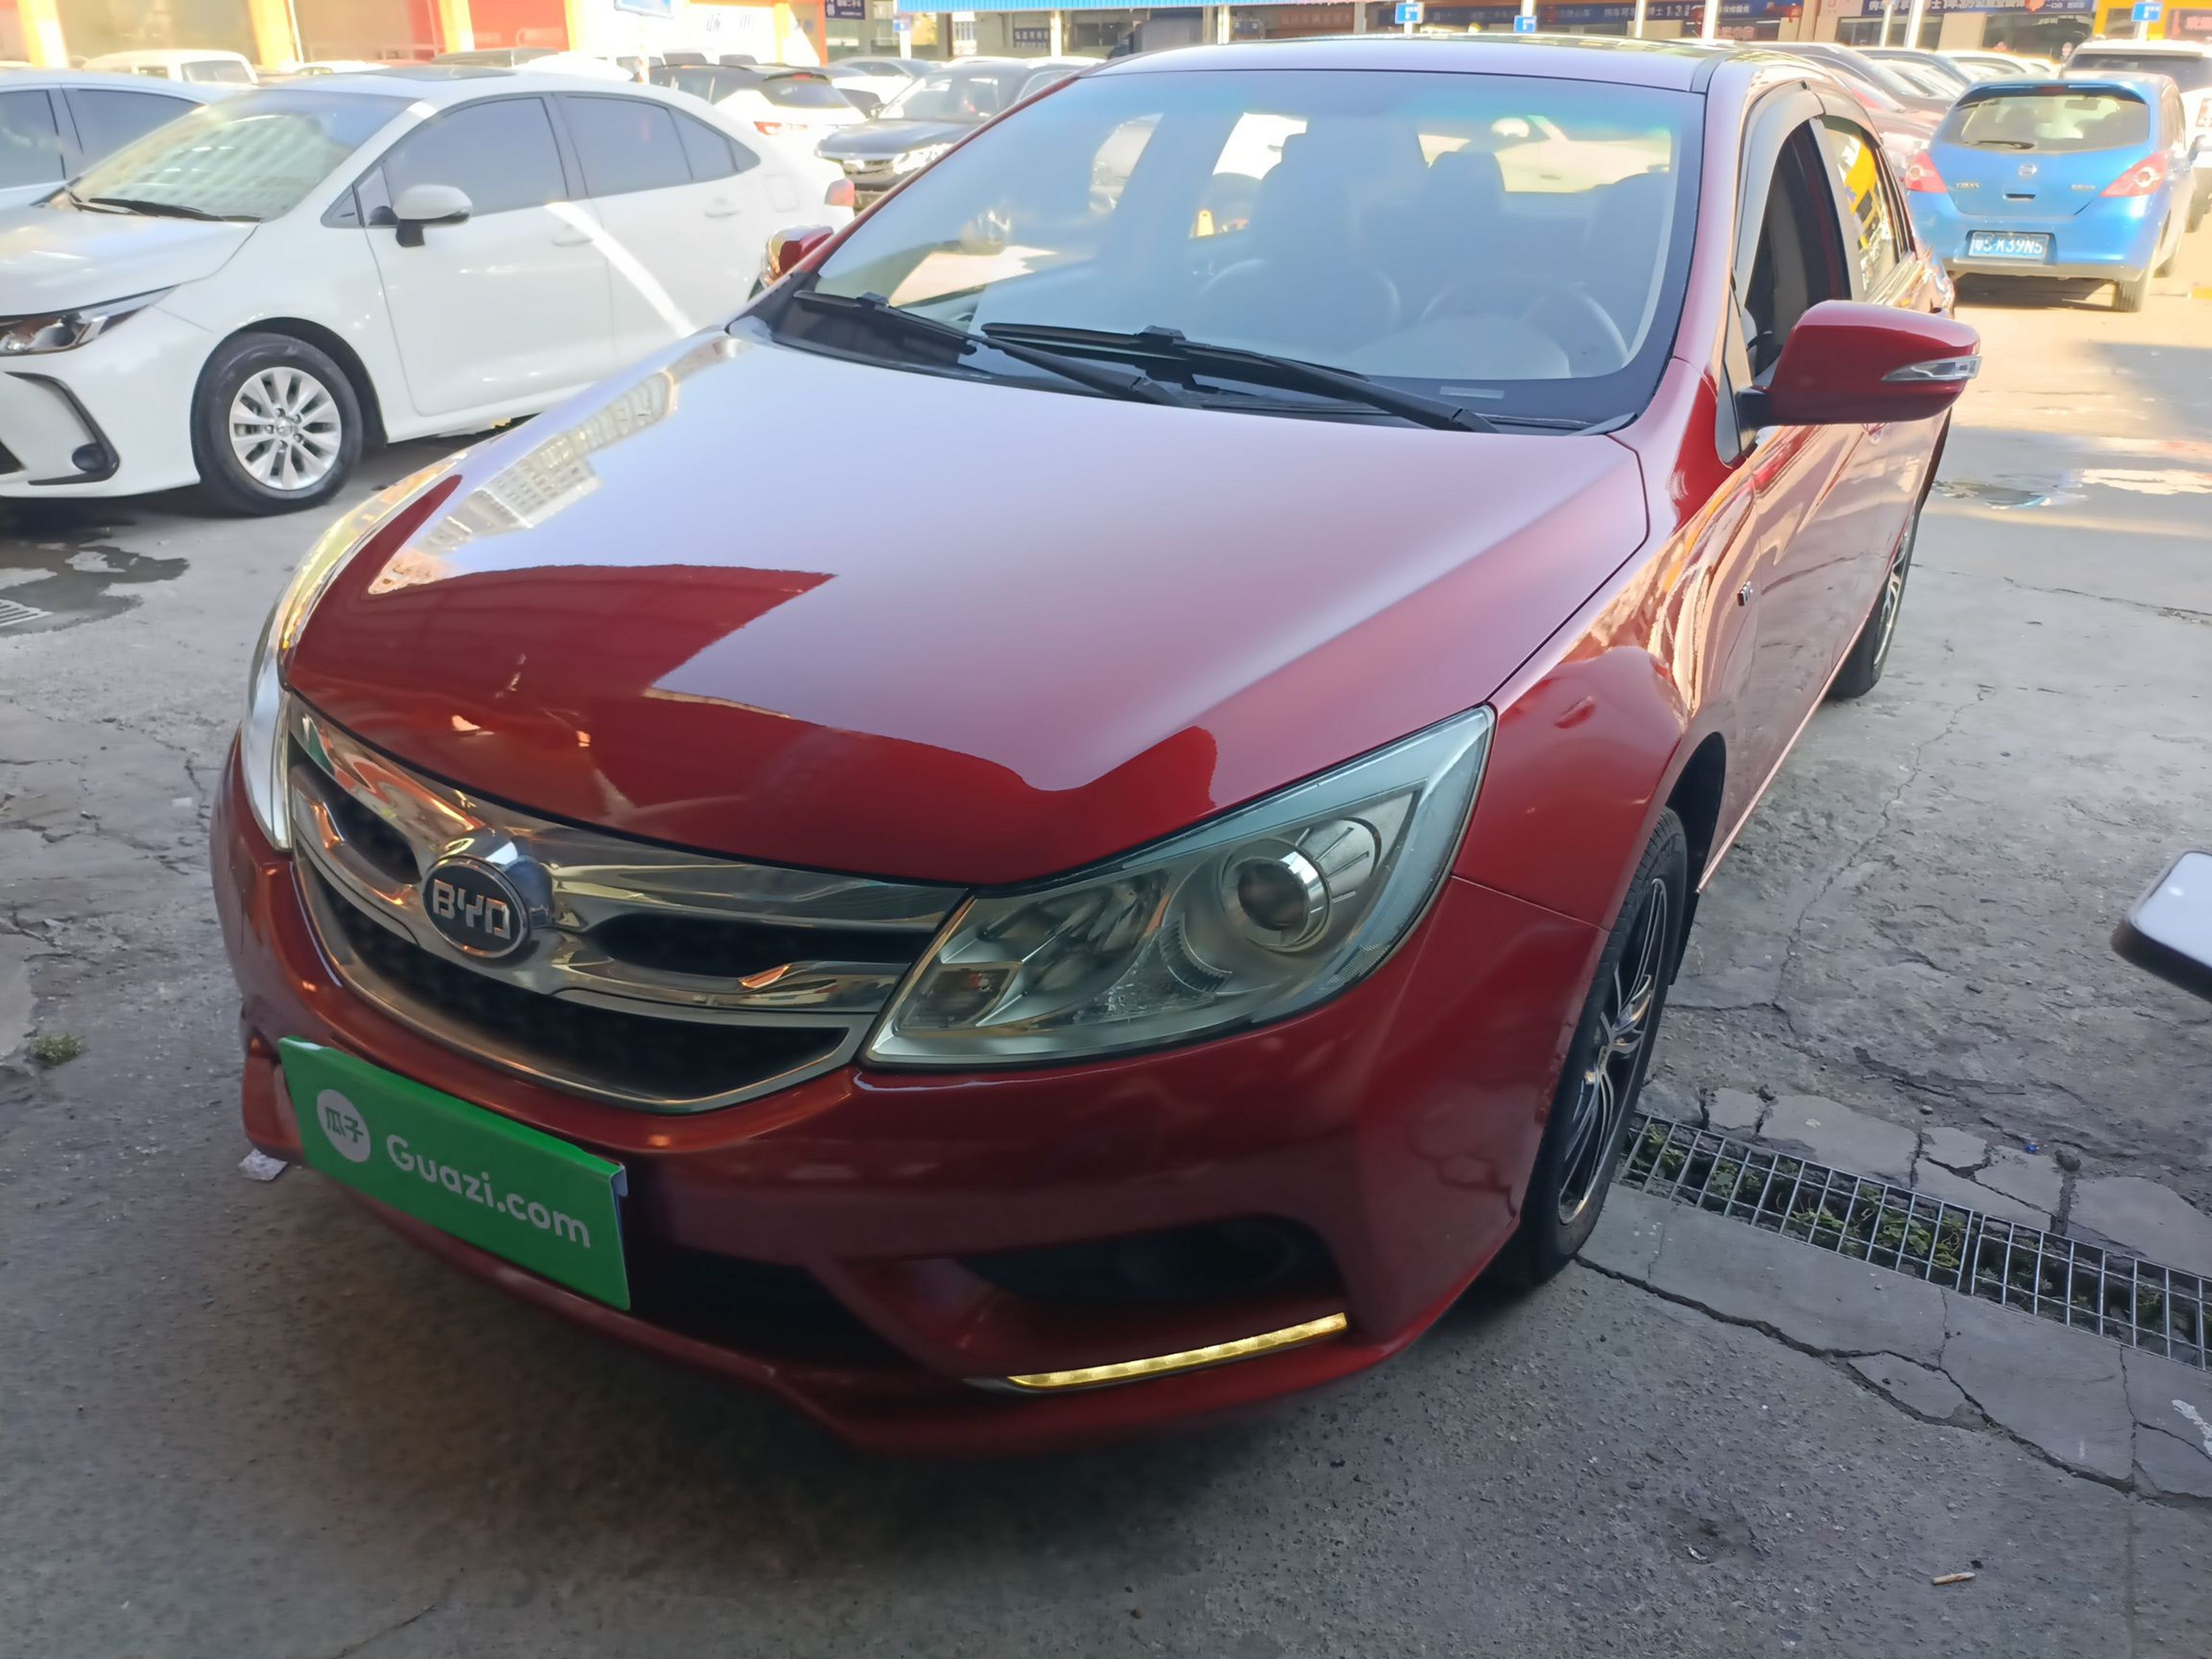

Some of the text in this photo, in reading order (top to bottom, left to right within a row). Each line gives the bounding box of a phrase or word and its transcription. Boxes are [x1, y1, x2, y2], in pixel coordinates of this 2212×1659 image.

[433, 878, 512, 940] BYD
[324, 1106, 364, 1143] 瓜子
[387, 1134, 590, 1248] Guazi.com
